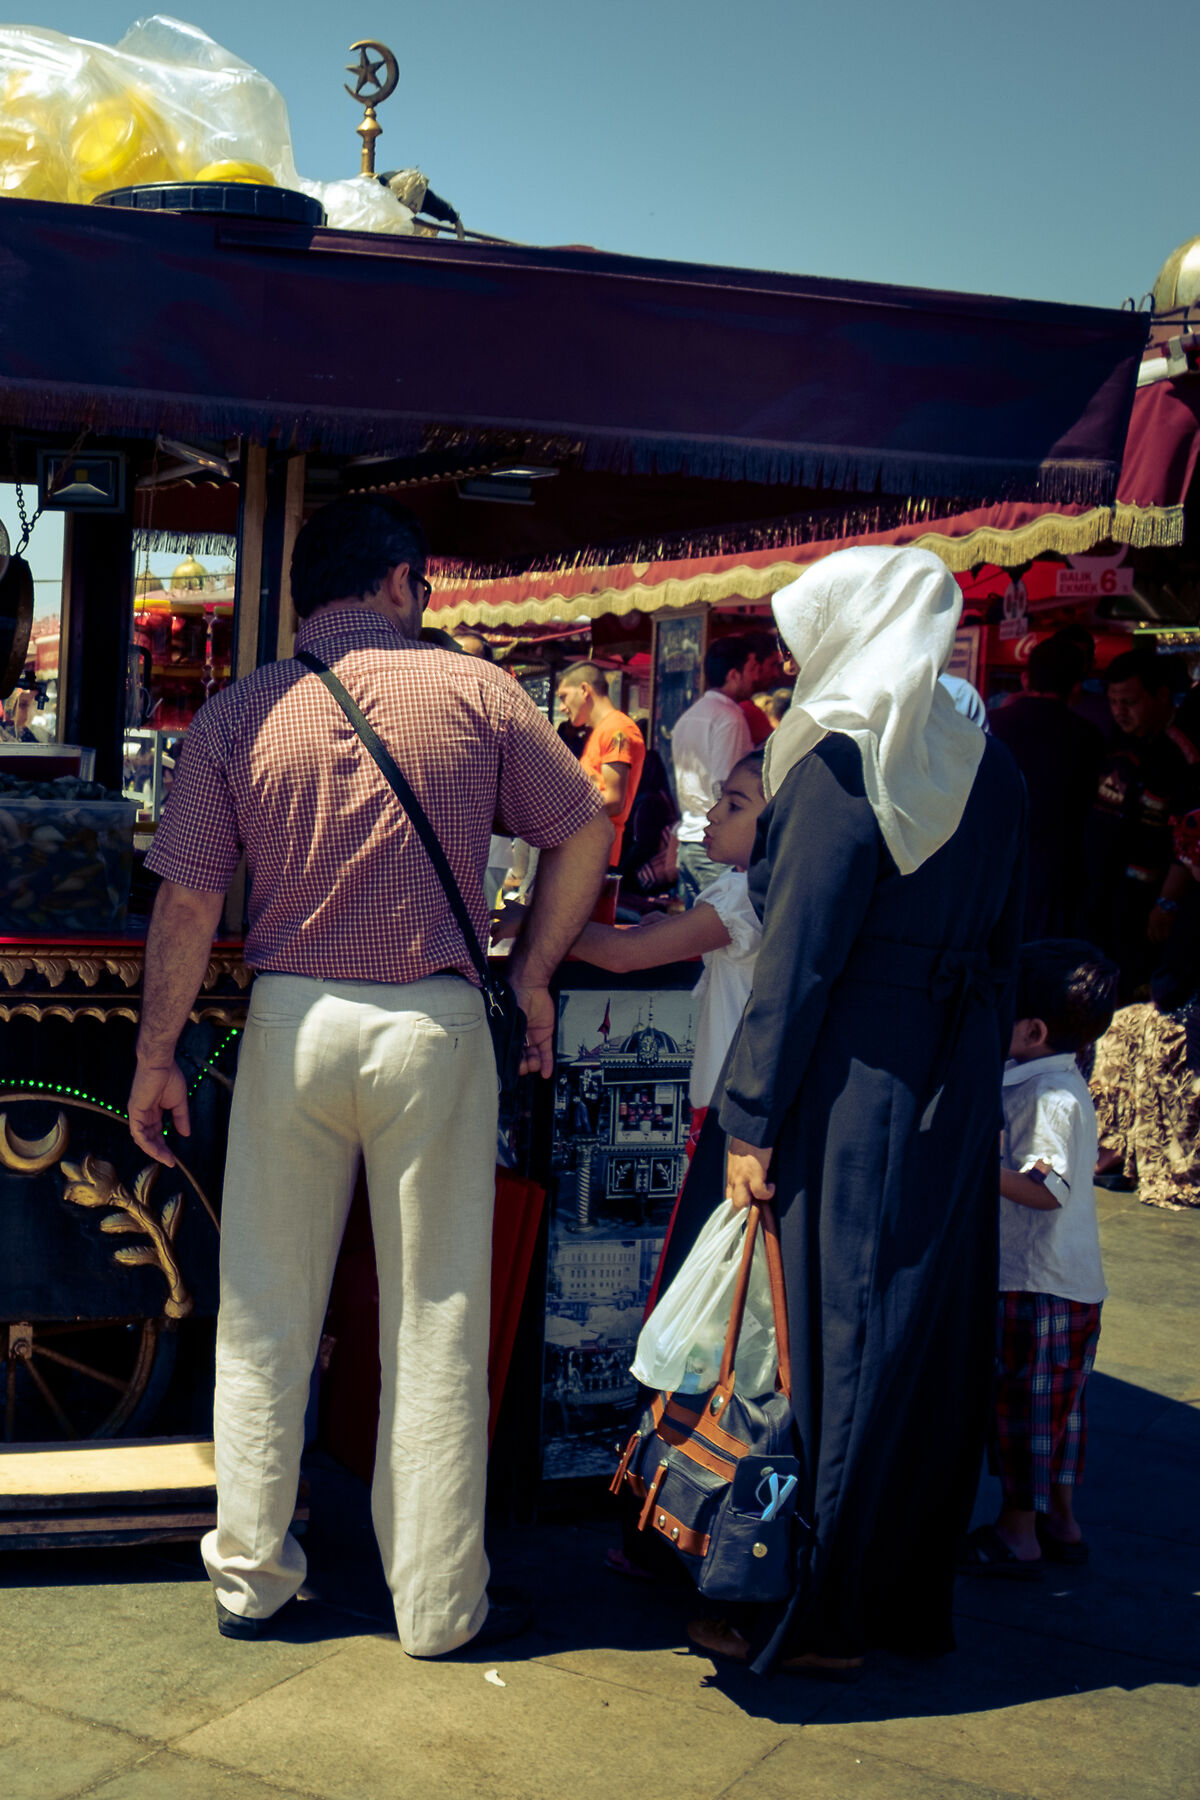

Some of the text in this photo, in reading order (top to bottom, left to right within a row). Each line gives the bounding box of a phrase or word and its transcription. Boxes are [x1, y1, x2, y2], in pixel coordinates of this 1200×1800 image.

[1060, 572, 1092, 582] BALIK
[1101, 568, 1117, 593] 6
[1060, 584, 1098, 593] EKMEK
